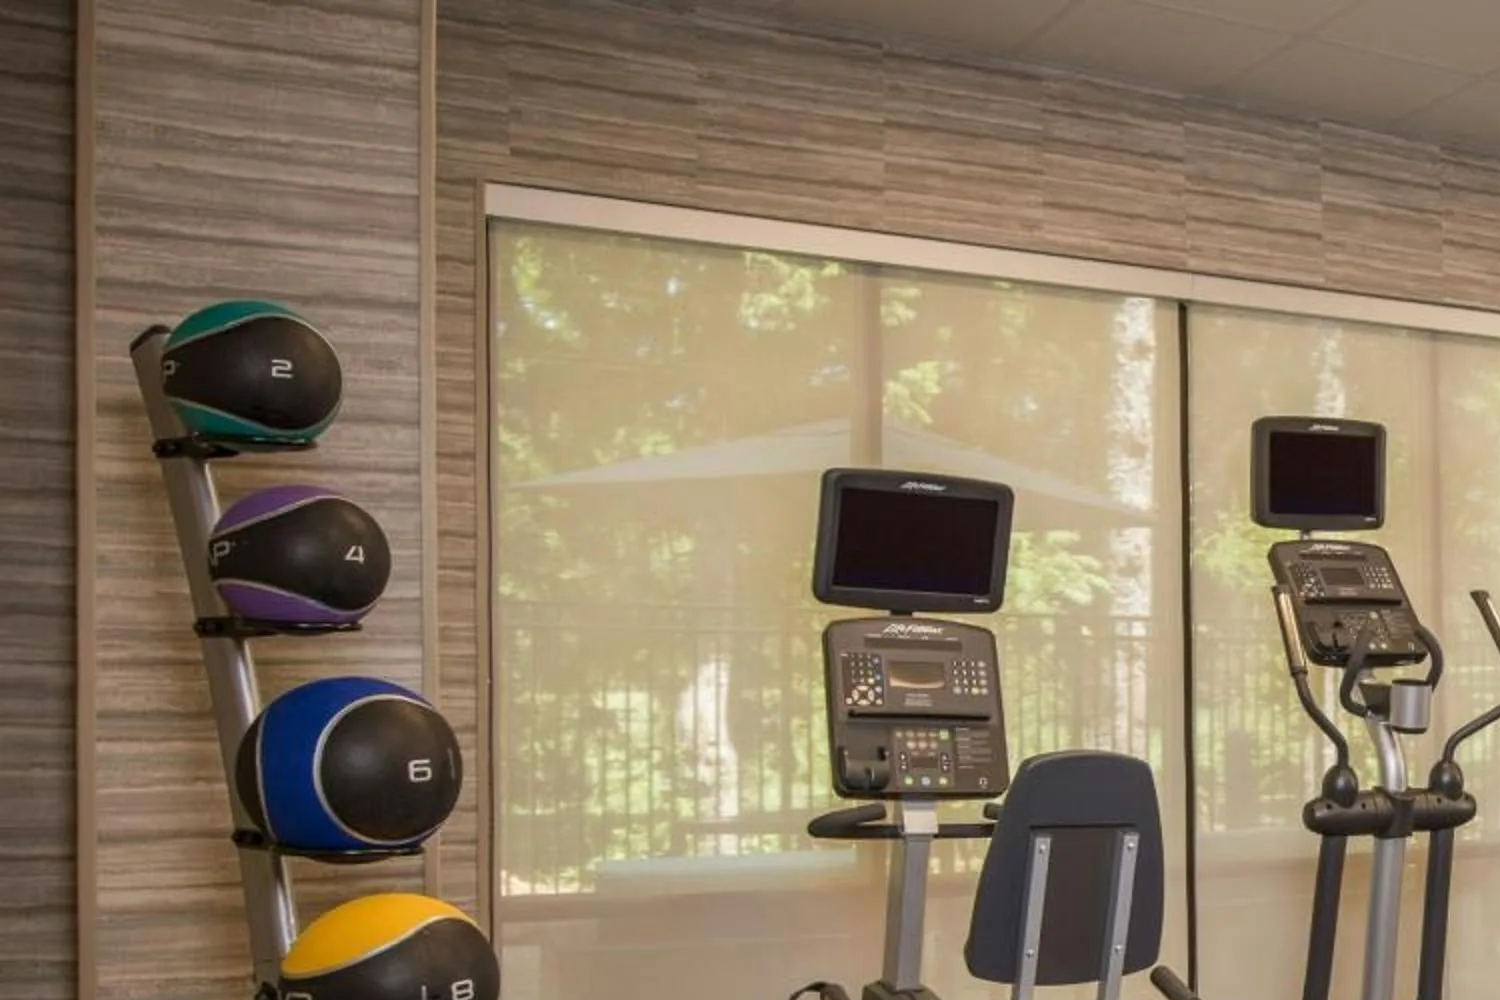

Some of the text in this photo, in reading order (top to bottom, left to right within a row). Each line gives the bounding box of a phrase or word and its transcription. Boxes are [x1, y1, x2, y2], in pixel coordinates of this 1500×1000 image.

[271, 359, 293, 378] 2
[345, 545, 365, 564] 4
[408, 759, 432, 782] 6
